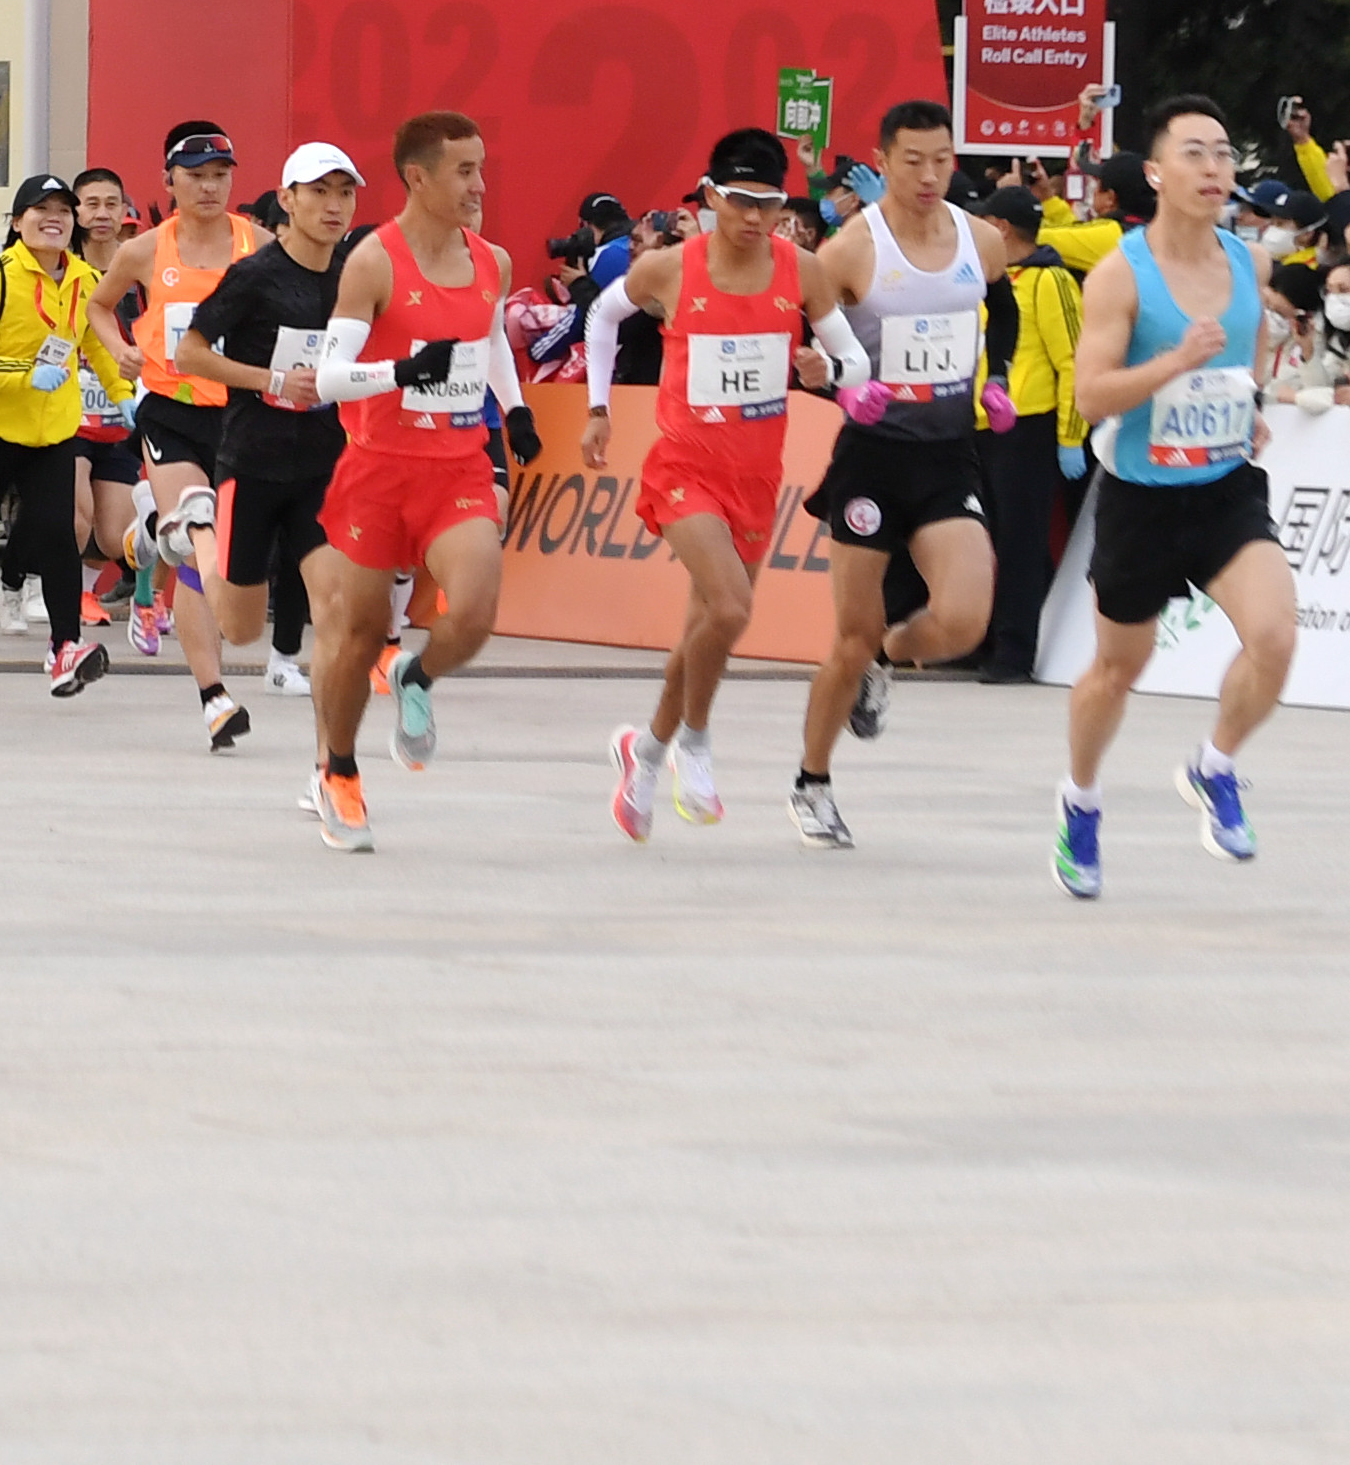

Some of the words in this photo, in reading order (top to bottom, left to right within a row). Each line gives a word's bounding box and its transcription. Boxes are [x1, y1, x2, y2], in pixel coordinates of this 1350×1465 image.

[982, 25, 1016, 42] Elite
[1019, 26, 1087, 43] Athletes
[981, 47, 1011, 64] Roll
[1012, 48, 1043, 64] Call
[1044, 49, 1088, 69] Entry
[905, 349, 928, 372] LI
[721, 370, 760, 393] HE
